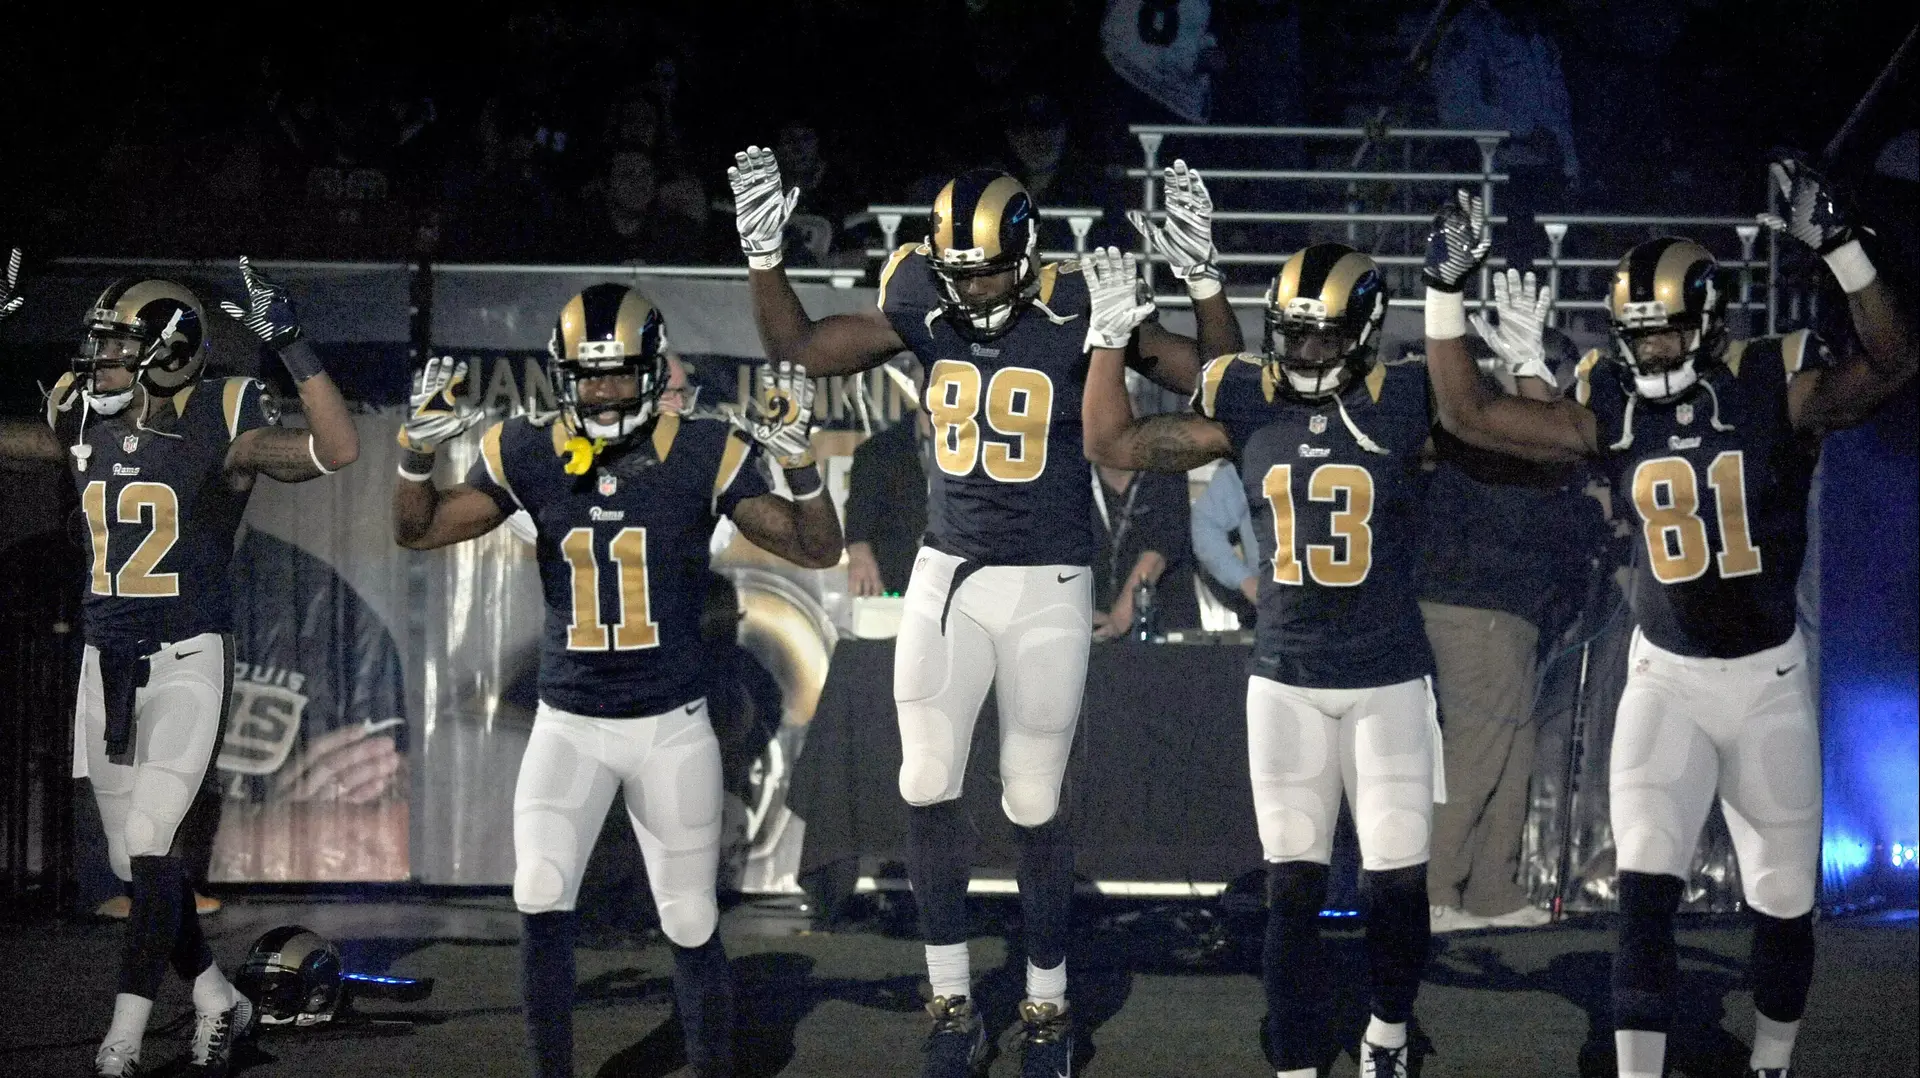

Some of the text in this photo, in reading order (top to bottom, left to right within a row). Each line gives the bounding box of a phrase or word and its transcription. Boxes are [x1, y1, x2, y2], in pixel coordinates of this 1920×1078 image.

[112, 463, 140, 476] Rams
[926, 359, 1053, 482] 89
[82, 481, 180, 598] 12
[1262, 464, 1374, 586] 13
[1632, 451, 1762, 584] 81
[561, 527, 660, 651] 11
